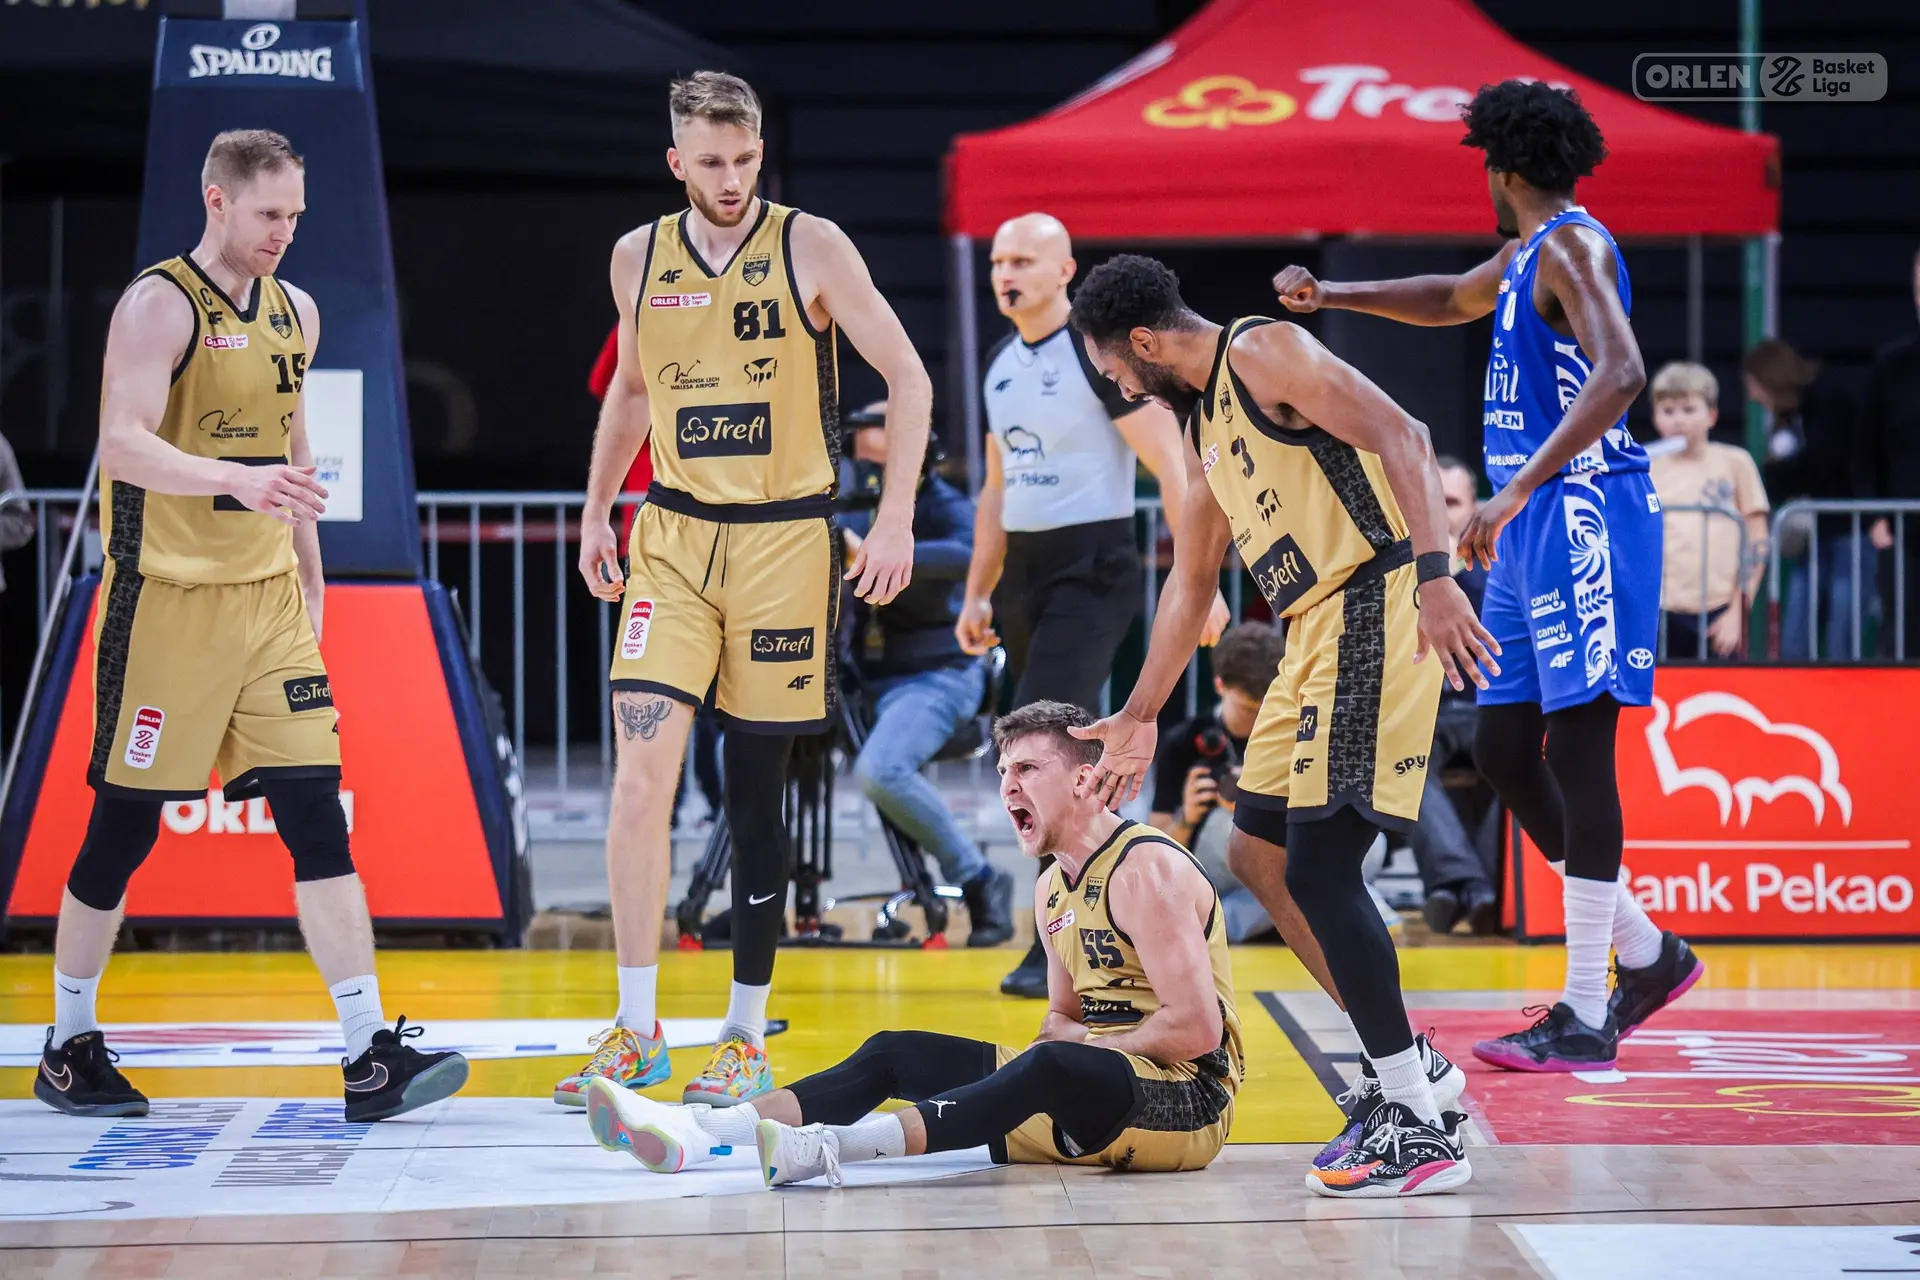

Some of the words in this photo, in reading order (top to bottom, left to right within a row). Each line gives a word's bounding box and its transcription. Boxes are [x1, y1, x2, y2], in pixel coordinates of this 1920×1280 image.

[189, 43, 335, 82] SPALDING
[1299, 64, 1573, 122] Tre
[658, 269, 683, 284] 4F
[652, 297, 678, 305] ORLEN
[733, 298, 786, 341] 81
[744, 358, 778, 390] Sopot
[711, 415, 766, 445] Trefl
[1230, 435, 1255, 480] 3
[1268, 551, 1302, 593] Trefl
[775, 635, 811, 655] Trefl
[1549, 650, 1575, 669] 4F
[787, 674, 814, 690] 4F
[139, 714, 161, 723] ORLEN
[1298, 714, 1314, 735] efl
[129, 749, 151, 758] Basket
[162, 789, 354, 834] ORL
[1745, 862, 1914, 914] Pekao
[1079, 927, 1125, 969] 55
